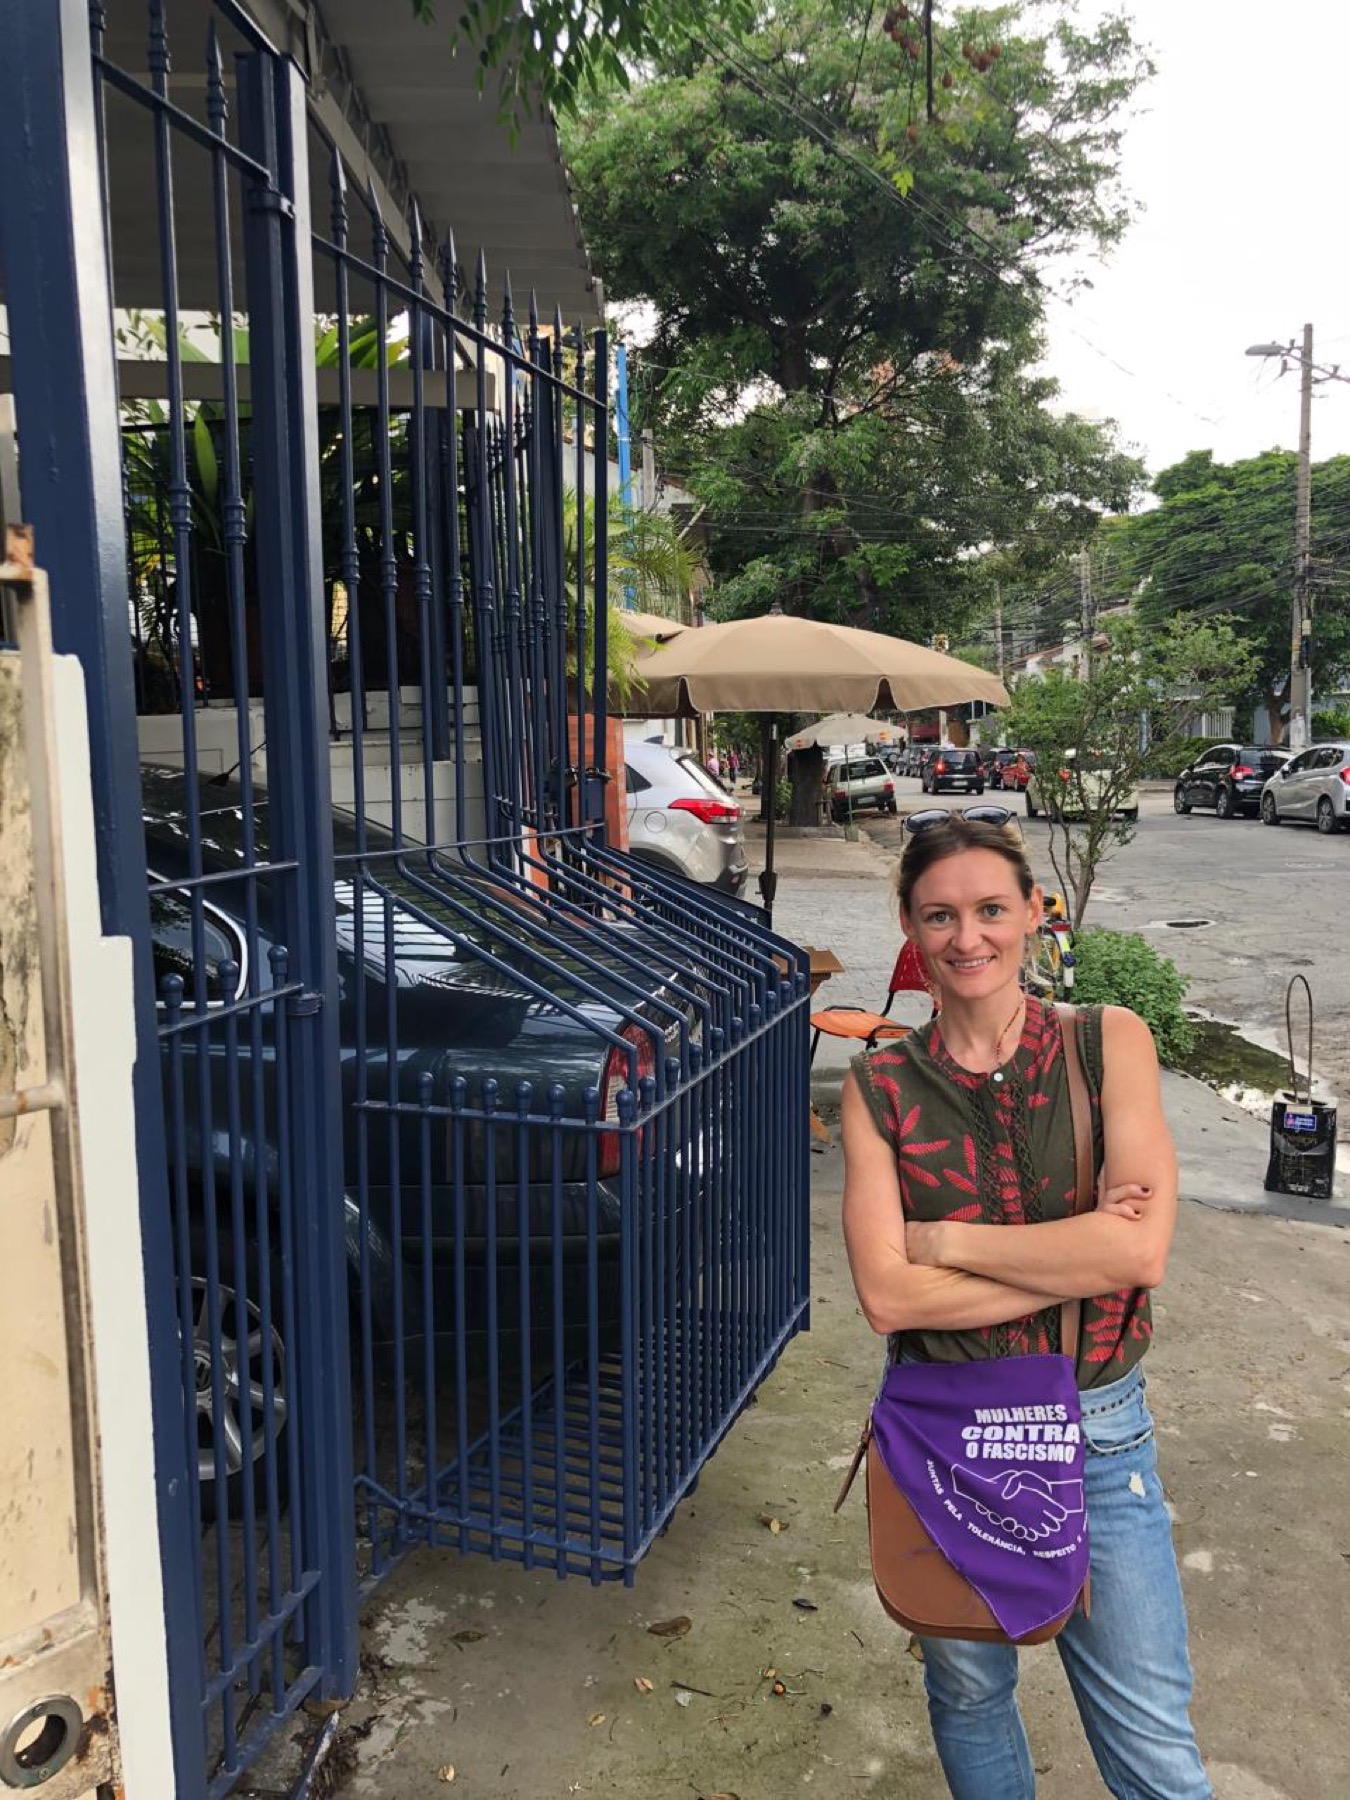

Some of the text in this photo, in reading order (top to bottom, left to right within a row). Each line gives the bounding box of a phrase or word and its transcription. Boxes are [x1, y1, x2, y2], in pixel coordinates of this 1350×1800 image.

[974, 1404, 1068, 1424] MULHERES
[961, 1423, 1080, 1444] CONTRA
[965, 1441, 1076, 1465] O FASCISMO
[926, 1459, 944, 1496] JUNTAS
[943, 1498, 963, 1521] PELA
